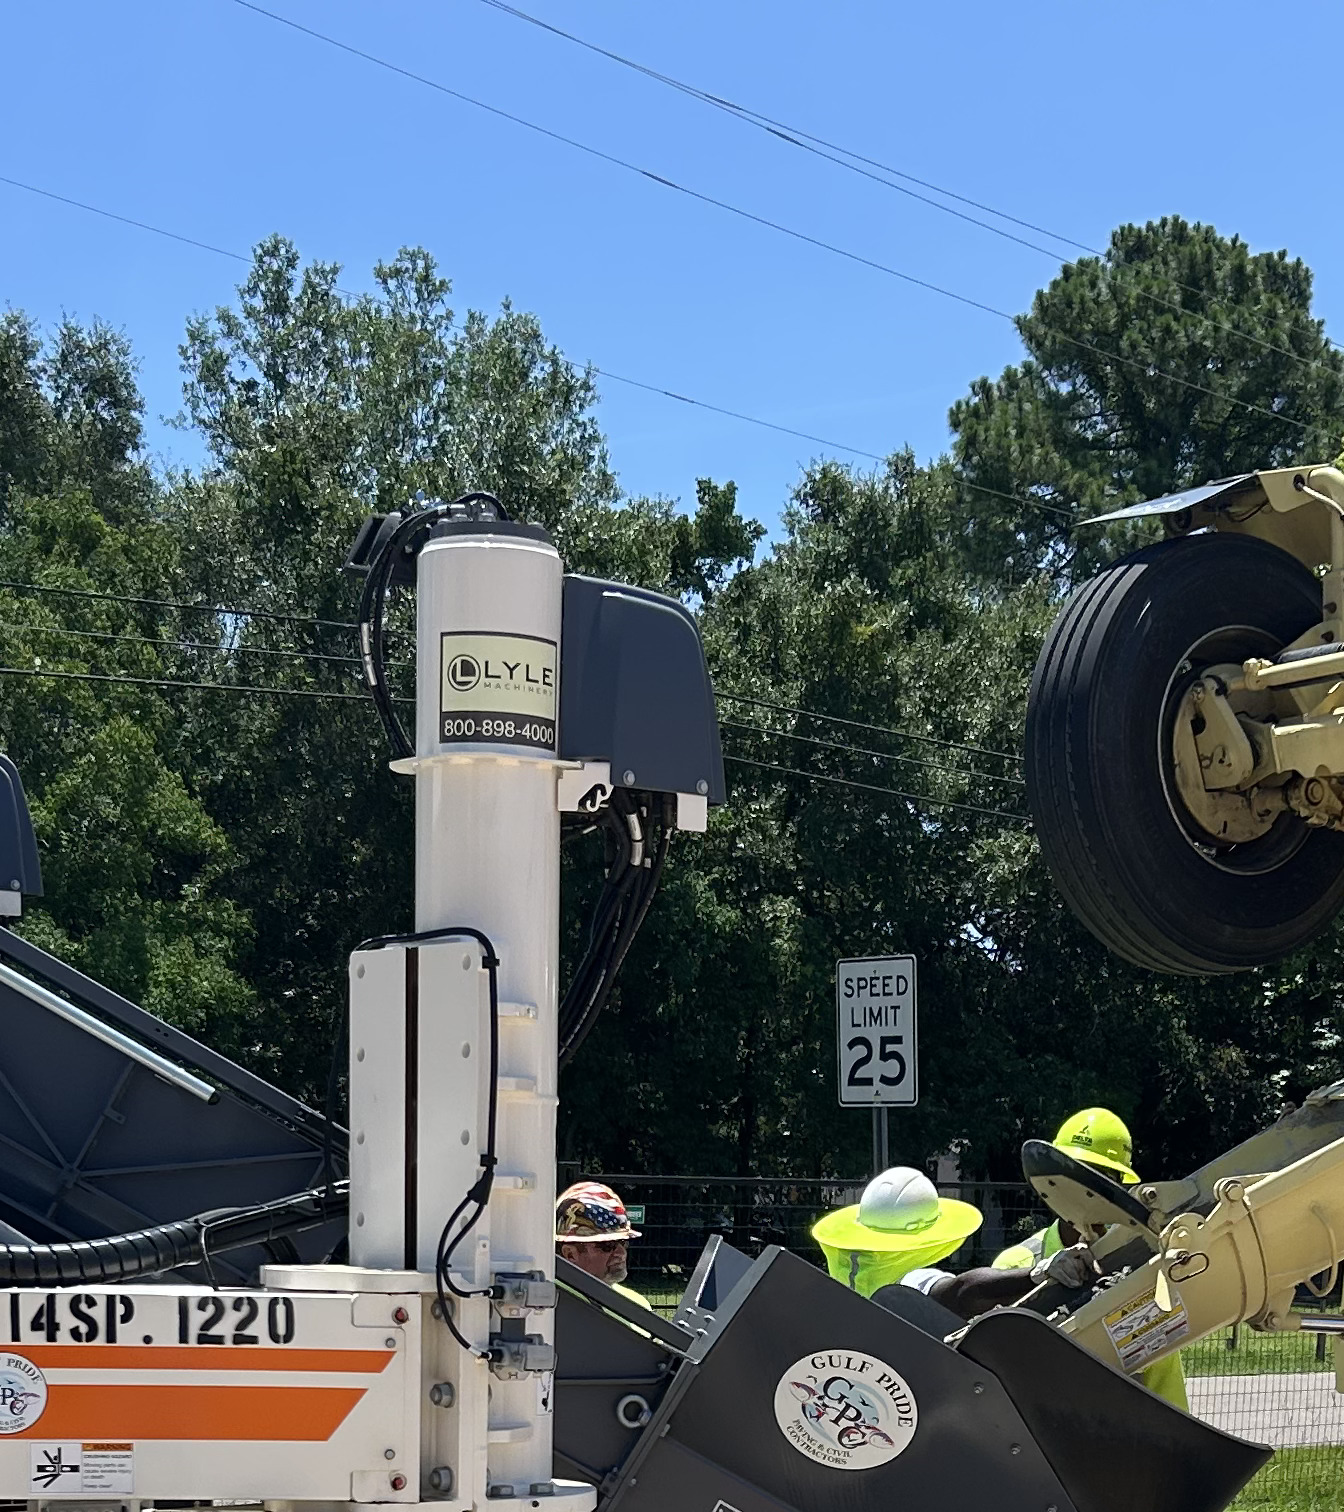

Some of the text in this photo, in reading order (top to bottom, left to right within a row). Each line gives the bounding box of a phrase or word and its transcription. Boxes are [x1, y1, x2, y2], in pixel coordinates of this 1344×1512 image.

[483, 660, 554, 687] LYLE
[483, 682, 554, 697] MACHINERY
[444, 719, 554, 744] 800-898-4000
[843, 975, 909, 998] SPEED
[851, 1005, 901, 1027] LIMIT
[846, 1036, 907, 1087] 25
[10, 1293, 296, 1345] 14SP. 1220
[6, 1358, 43, 1384] PRIDE
[811, 1354, 914, 1428] GULF PRIDE
[786, 1425, 848, 1466] CONTRACTORS
